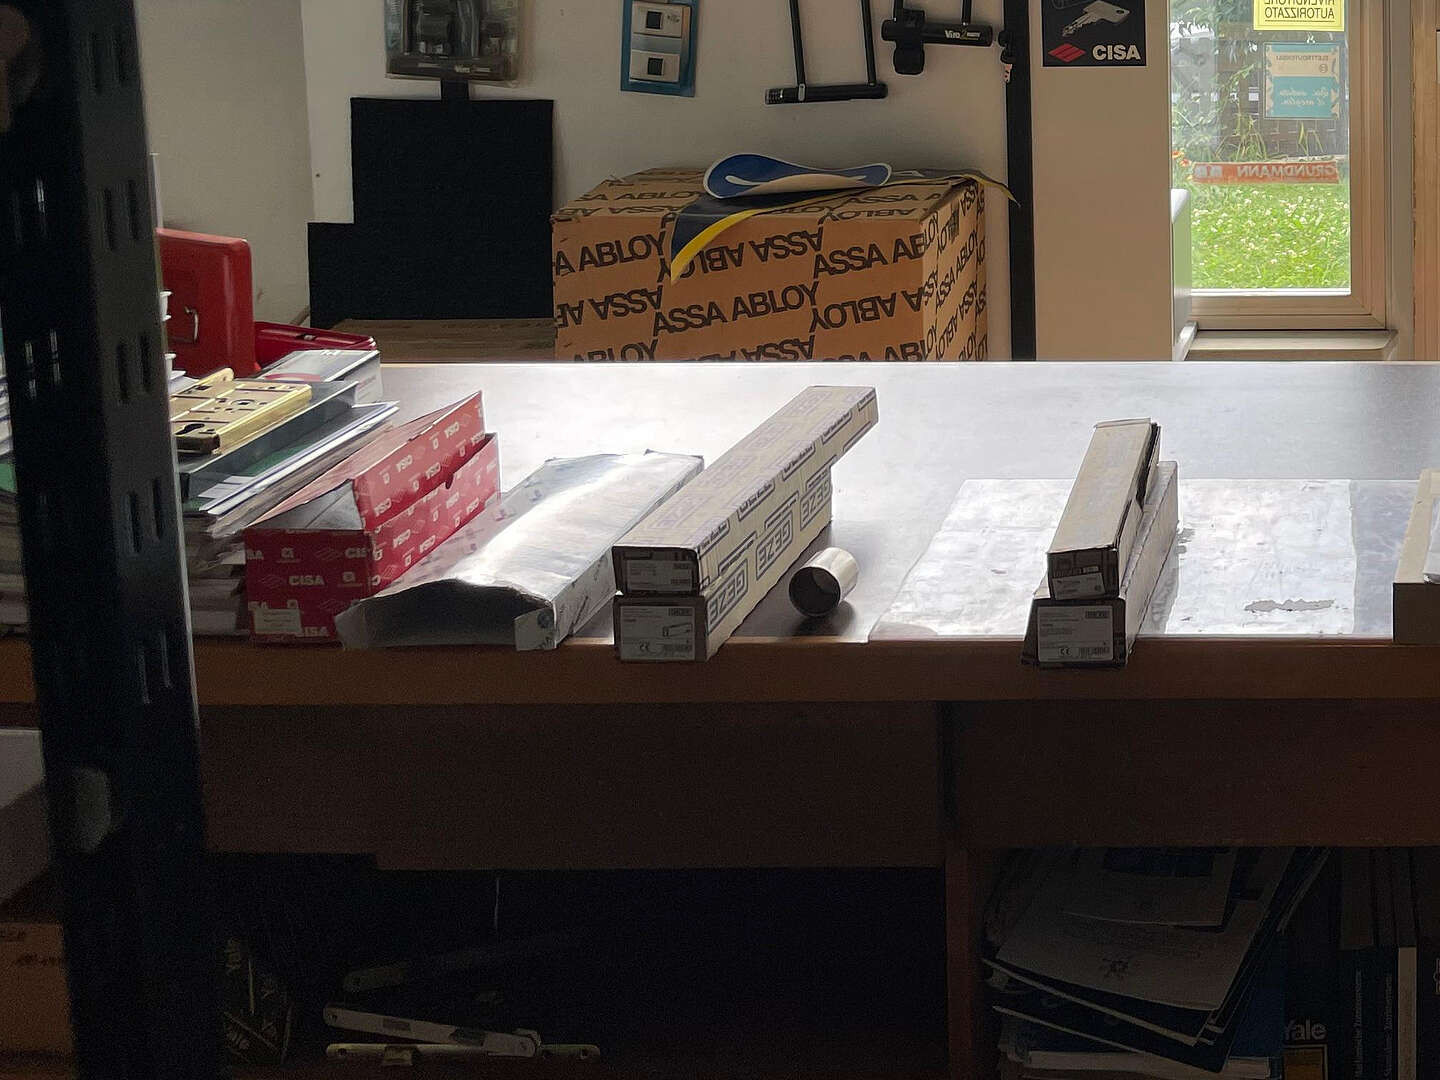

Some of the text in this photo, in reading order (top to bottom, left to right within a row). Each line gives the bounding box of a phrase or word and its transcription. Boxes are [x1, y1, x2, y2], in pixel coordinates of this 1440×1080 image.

[1092, 44, 1141, 61] CISA
[579, 233, 666, 272] ABLOY
[749, 231, 823, 263] ASSA
[813, 244, 889, 279] ASSA
[588, 289, 662, 321] ASSA
[653, 282, 819, 337] ASSA ABLOY
[809, 292, 898, 333] ABLOY
[758, 520, 792, 566] GEZE
[288, 574, 325, 587] CISA
[709, 573, 746, 621] GEZE
[302, 626, 329, 637] ISA
